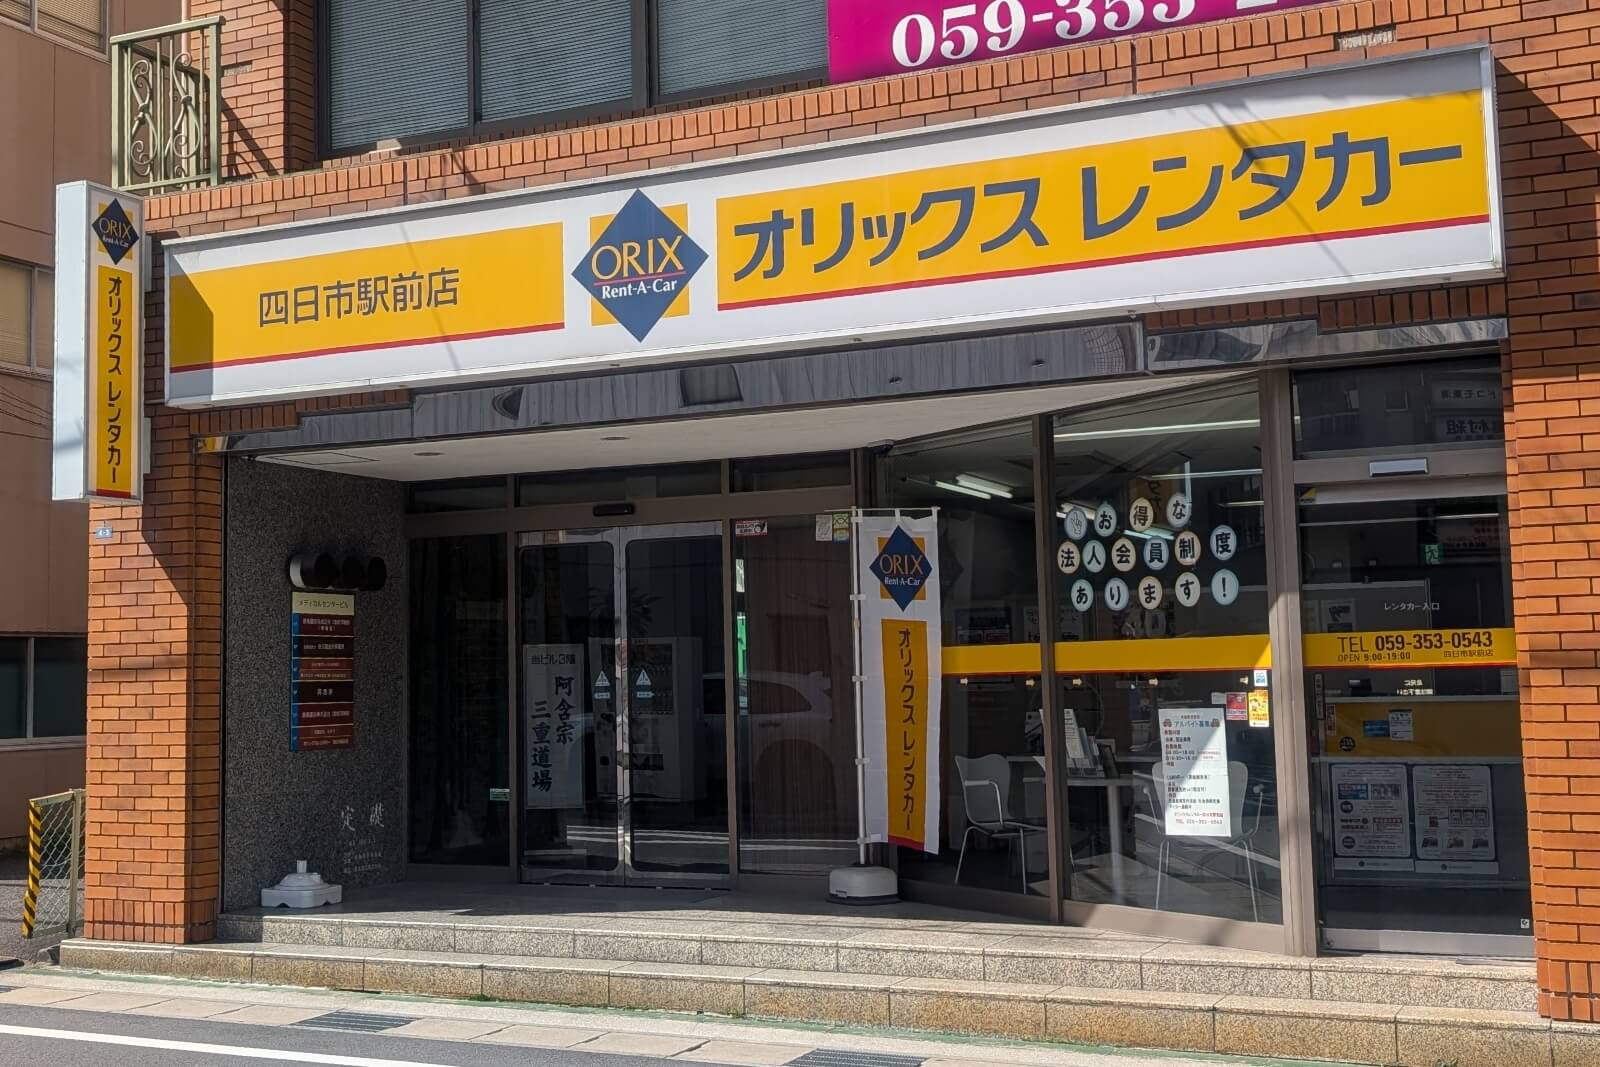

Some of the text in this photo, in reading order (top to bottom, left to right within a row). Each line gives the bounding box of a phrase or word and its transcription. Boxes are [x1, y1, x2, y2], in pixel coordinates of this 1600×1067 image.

[734, 132, 1463, 282] オリックス レンタカー
[99, 216, 132, 240] ORIX
[591, 235, 683, 281] ORIX
[259, 267, 460, 328] 四日市駅前店
[602, 277, 678, 299] Rent-A-Car
[106, 275, 123, 483] オリックス レンタカー
[1098, 500, 1187, 530] お得な
[880, 554, 924, 576] ORIX
[1061, 532, 1231, 569] 法人会員制度
[1384, 602, 1441, 611] レンタカー入口
[1337, 631, 1493, 653] TEL 059-353-0543
[1338, 651, 1411, 662] OPEN 9:00-19:00
[554, 676, 576, 745] 阿含宗
[531, 700, 553, 793] 三重道場
[897, 628, 916, 831] オリックス レンタカー
